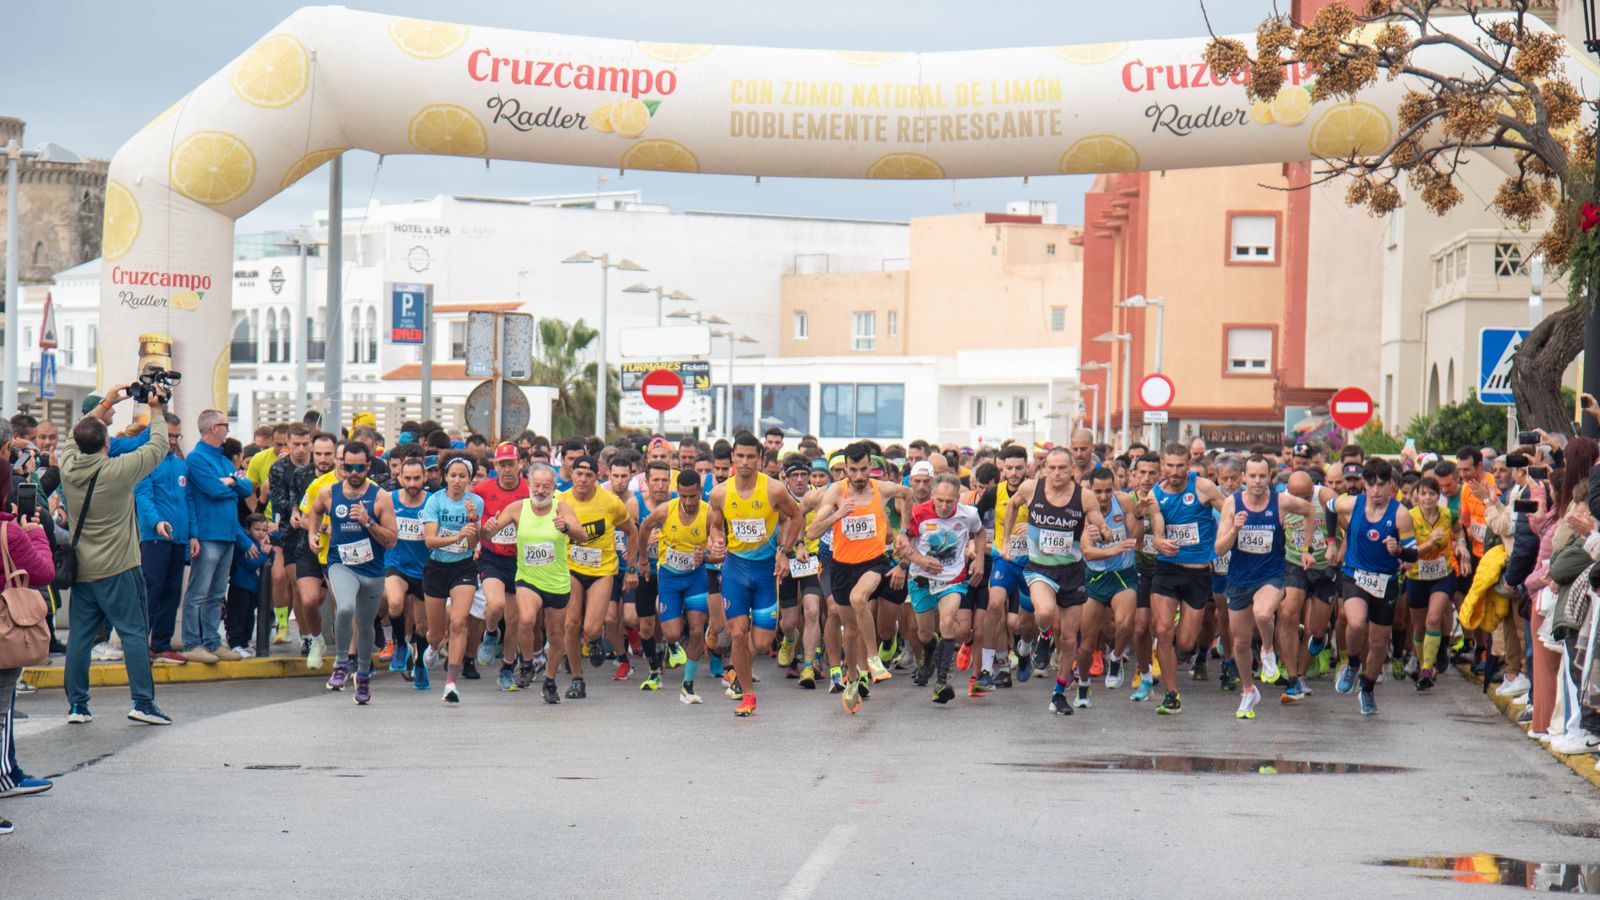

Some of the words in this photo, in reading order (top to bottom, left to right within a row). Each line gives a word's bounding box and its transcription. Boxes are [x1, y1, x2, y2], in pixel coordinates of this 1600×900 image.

[468, 48, 677, 98] Cruzcampo
[1122, 57, 1324, 93] Cruzcap
[730, 80, 774, 105] CON
[781, 81, 843, 107] ZUMO
[852, 82, 947, 108] NATURAL
[956, 80, 983, 106] DE
[991, 76, 1062, 105] LIMÓN
[486, 93, 588, 132] Radler
[1144, 100, 1249, 136] Radler
[730, 109, 888, 142] DOBLEMENTE
[898, 109, 1063, 143] REFRESCANTE
[394, 224, 423, 233] HOTEL
[434, 225, 450, 234] SPA
[112, 266, 211, 291] Cruzcampo
[118, 290, 168, 309] Radler
[402, 293, 413, 317] P
[741, 525, 757, 534] 356
[851, 522, 867, 532] 199
[1048, 537, 1064, 546] 168
[1247, 536, 1263, 545] 349
[352, 548, 358, 557] 4
[530, 549, 547, 559] 200
[582, 552, 587, 560] 3
[674, 556, 689, 564] 156
[1362, 576, 1378, 588] 394
